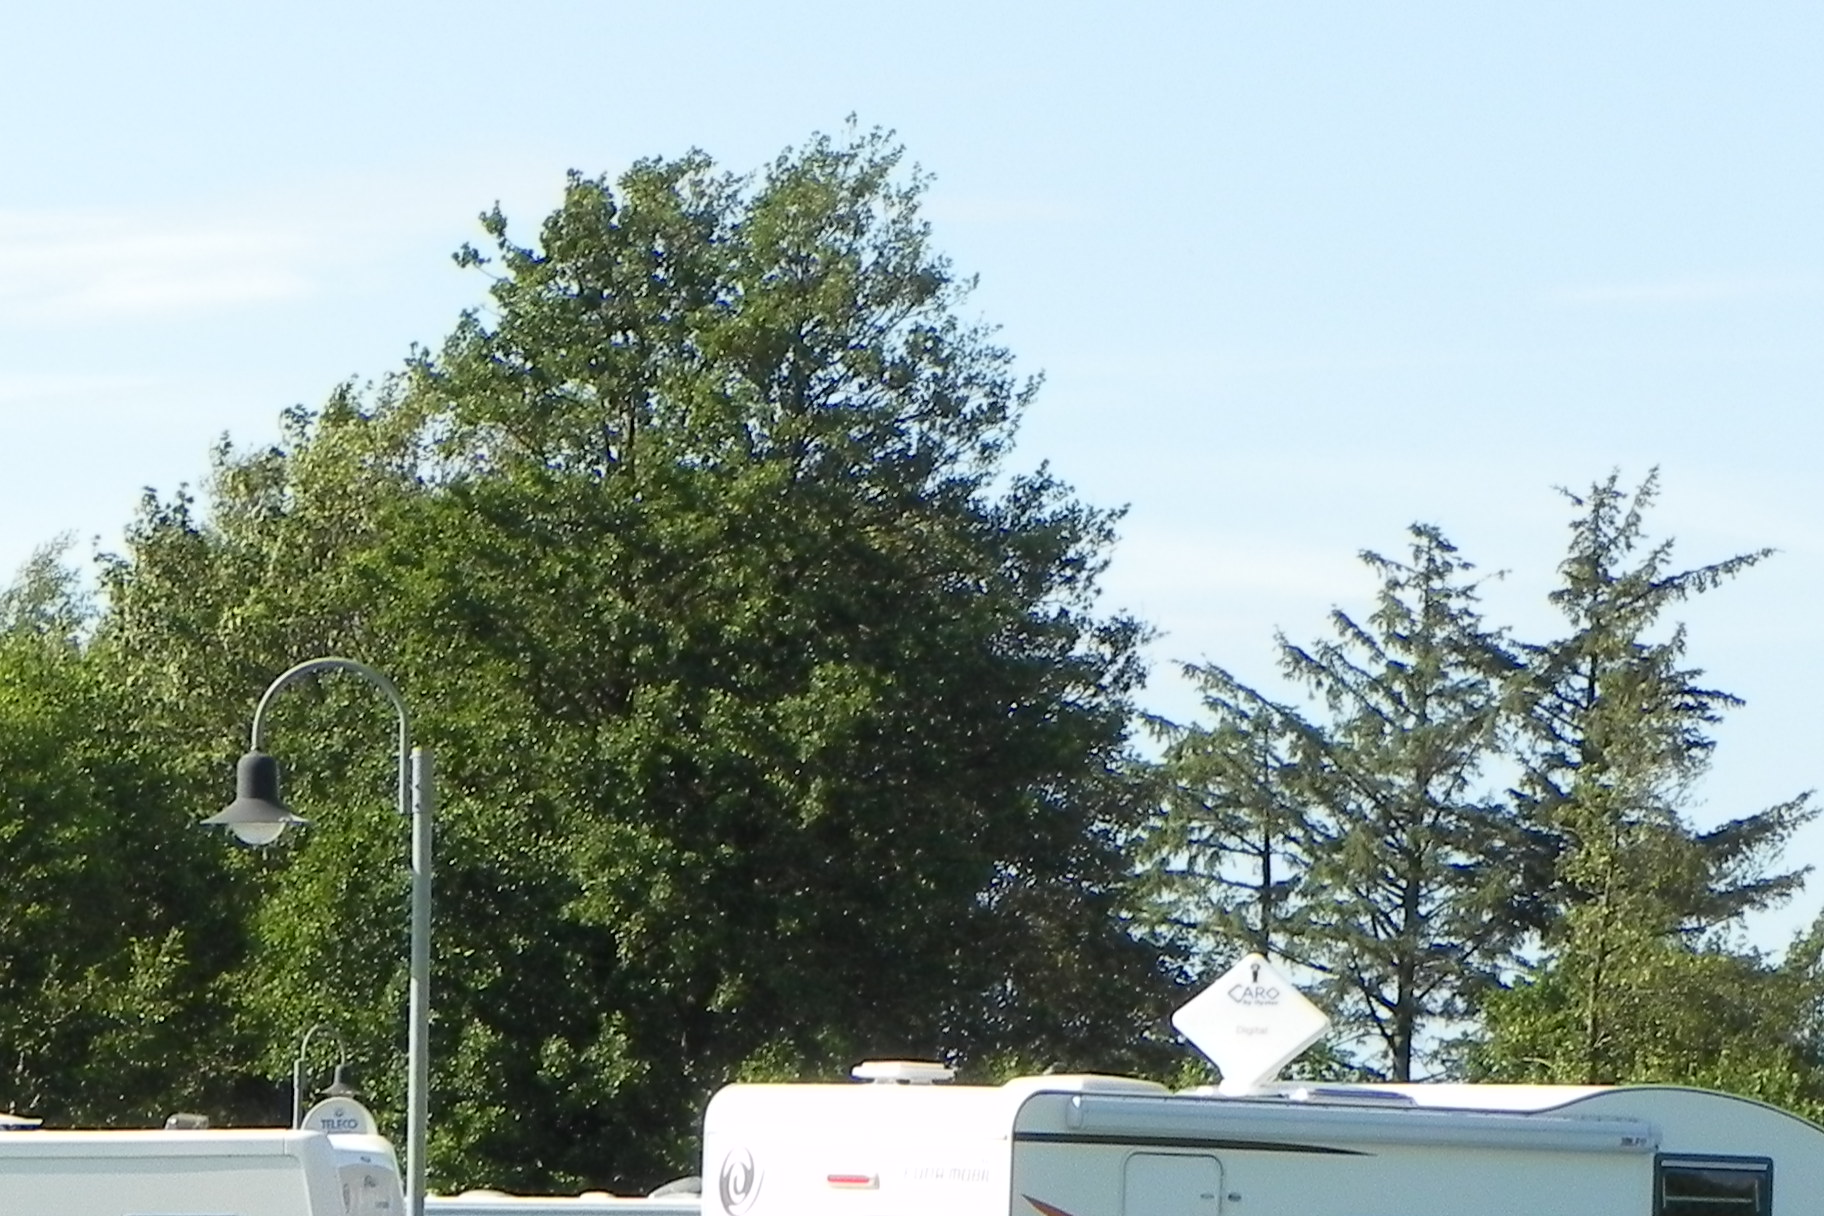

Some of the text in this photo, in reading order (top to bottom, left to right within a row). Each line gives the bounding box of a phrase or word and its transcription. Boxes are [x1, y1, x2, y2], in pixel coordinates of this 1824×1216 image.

[1227, 984, 1280, 1003] CARO
[1236, 1024, 1269, 1036] Digital
[321, 1119, 358, 1129] TELECO
